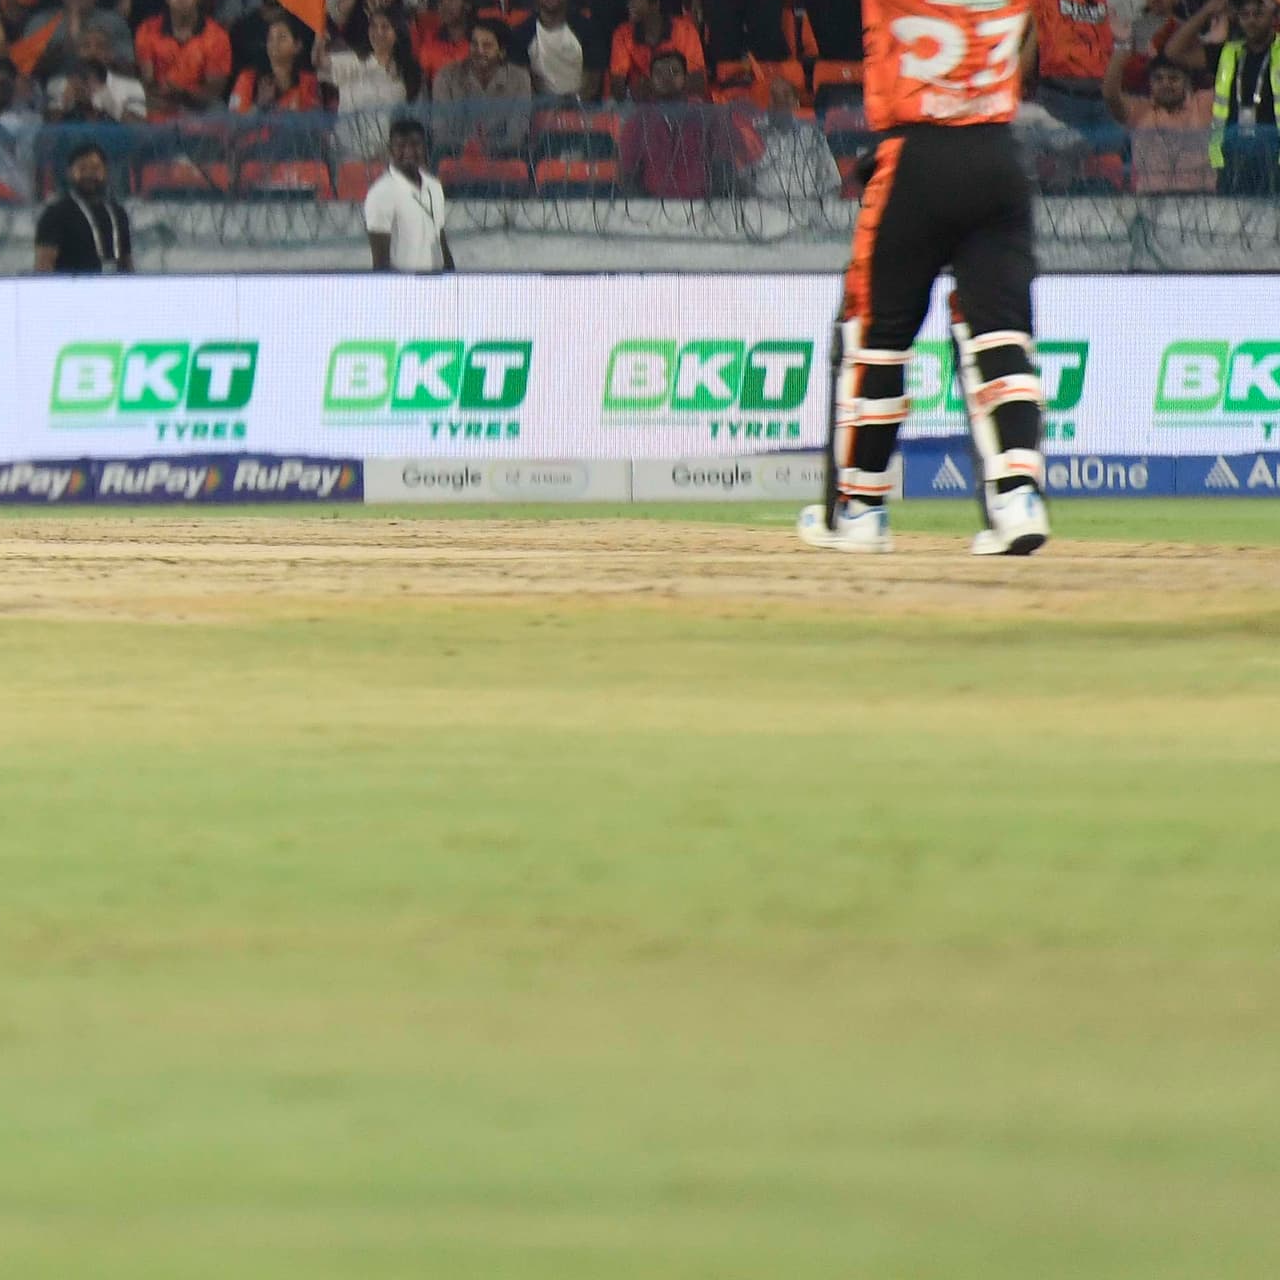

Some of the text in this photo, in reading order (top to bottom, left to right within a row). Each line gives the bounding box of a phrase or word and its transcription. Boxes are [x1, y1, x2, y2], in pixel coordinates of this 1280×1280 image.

[50, 341, 258, 412] BKT
[324, 340, 531, 411] BKT
[604, 340, 814, 411] BKT
[906, 341, 1089, 411] BT
[156, 422, 248, 442] TYRES
[429, 421, 522, 441] TYRES
[709, 420, 801, 441] TYRES
[99, 461, 209, 499] RuPay
[232, 458, 342, 497] RuPay
[402, 464, 482, 493] Google
[672, 463, 752, 491] Google
[1041, 457, 1149, 489] elOne
